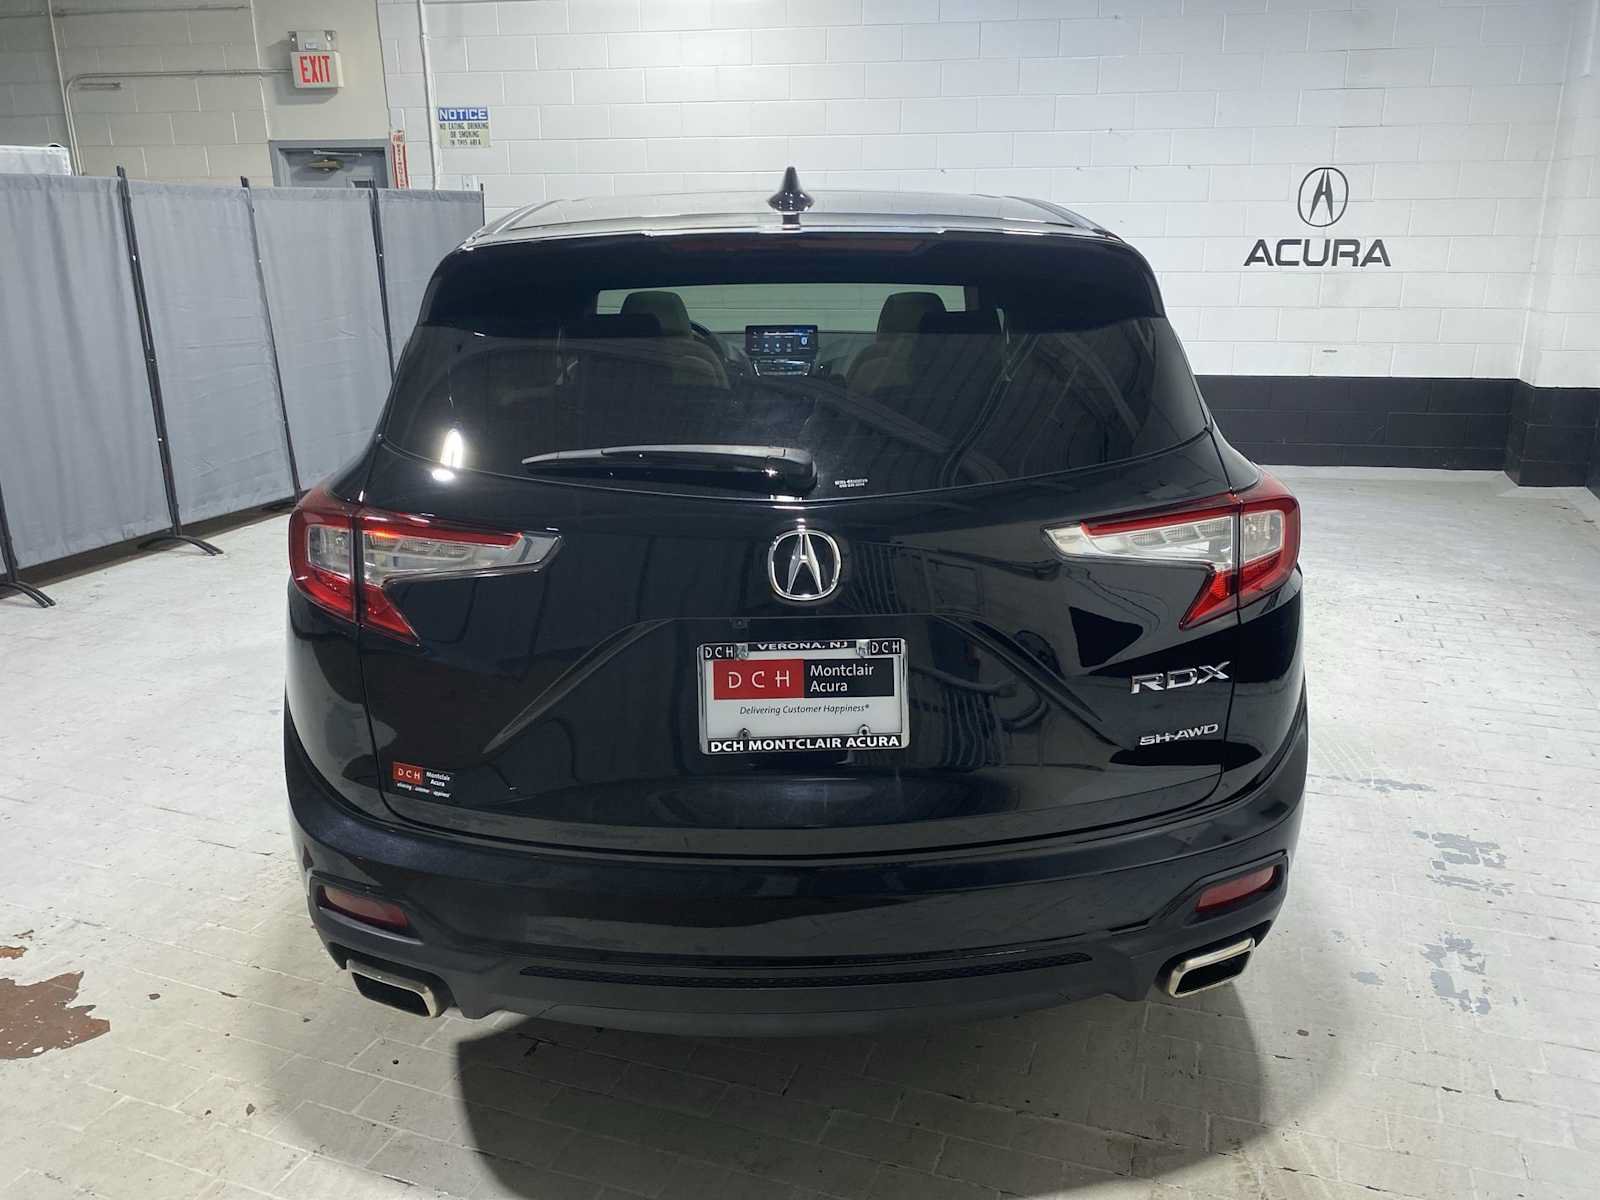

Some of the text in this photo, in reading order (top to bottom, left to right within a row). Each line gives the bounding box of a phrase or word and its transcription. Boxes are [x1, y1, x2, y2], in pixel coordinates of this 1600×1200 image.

[299, 55, 330, 83] EXIT
[439, 109, 488, 120] NOTICE
[458, 131, 480, 139] SMOKING
[1243, 239, 1391, 267] ACURA
[704, 645, 734, 659] DCH
[829, 641, 848, 649] NJ
[871, 641, 900, 654] DCH
[810, 663, 874, 677] Montclair
[728, 670, 790, 689] DCH
[1131, 661, 1231, 694] RDX
[810, 680, 848, 693] Acura
[739, 705, 781, 717] Delivering
[782, 704, 821, 714] Customer
[1140, 723, 1219, 746] SH-AWD
[710, 736, 900, 753] DCH MONTCLAIR ACURA
[397, 768, 421, 780] DCH
